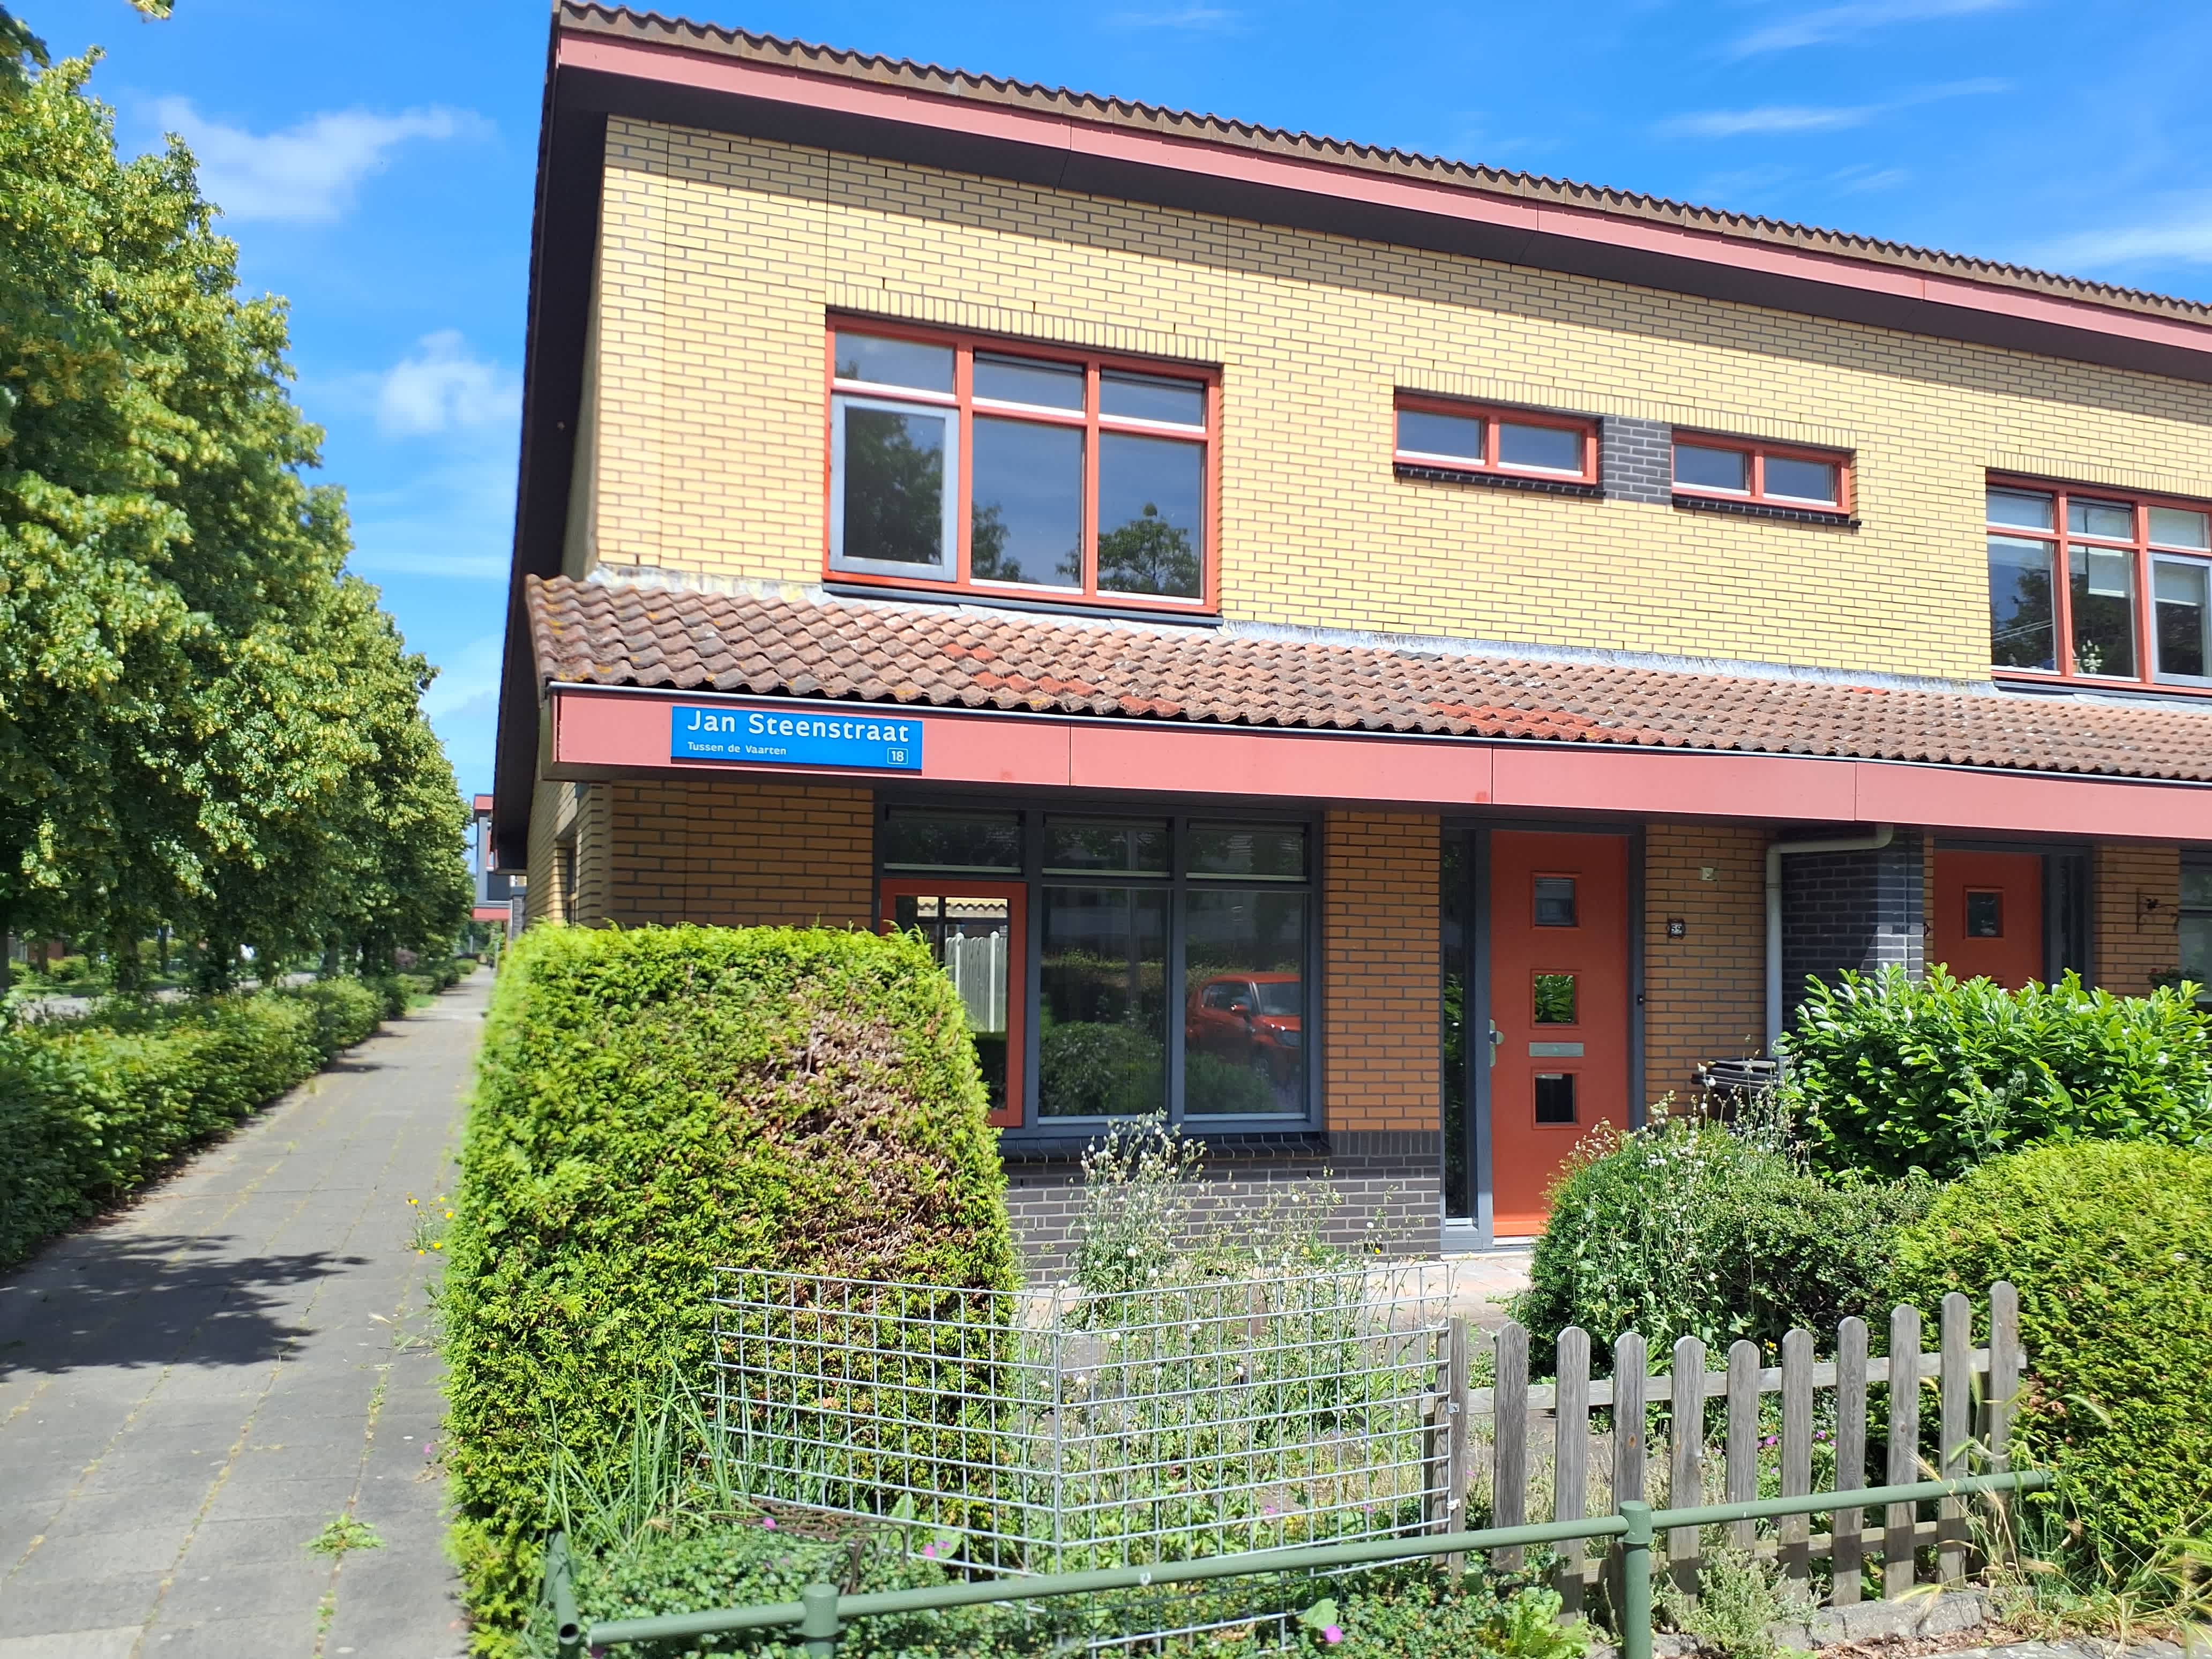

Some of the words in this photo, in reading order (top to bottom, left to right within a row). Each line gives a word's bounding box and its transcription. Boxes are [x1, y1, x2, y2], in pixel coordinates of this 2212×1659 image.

[687, 710, 736, 733] Jan
[749, 713, 909, 743] Steenstraat
[687, 741, 724, 752] Tussen
[728, 743, 741, 753] de
[745, 745, 787, 756] Vaarten
[891, 750, 905, 763] 18
